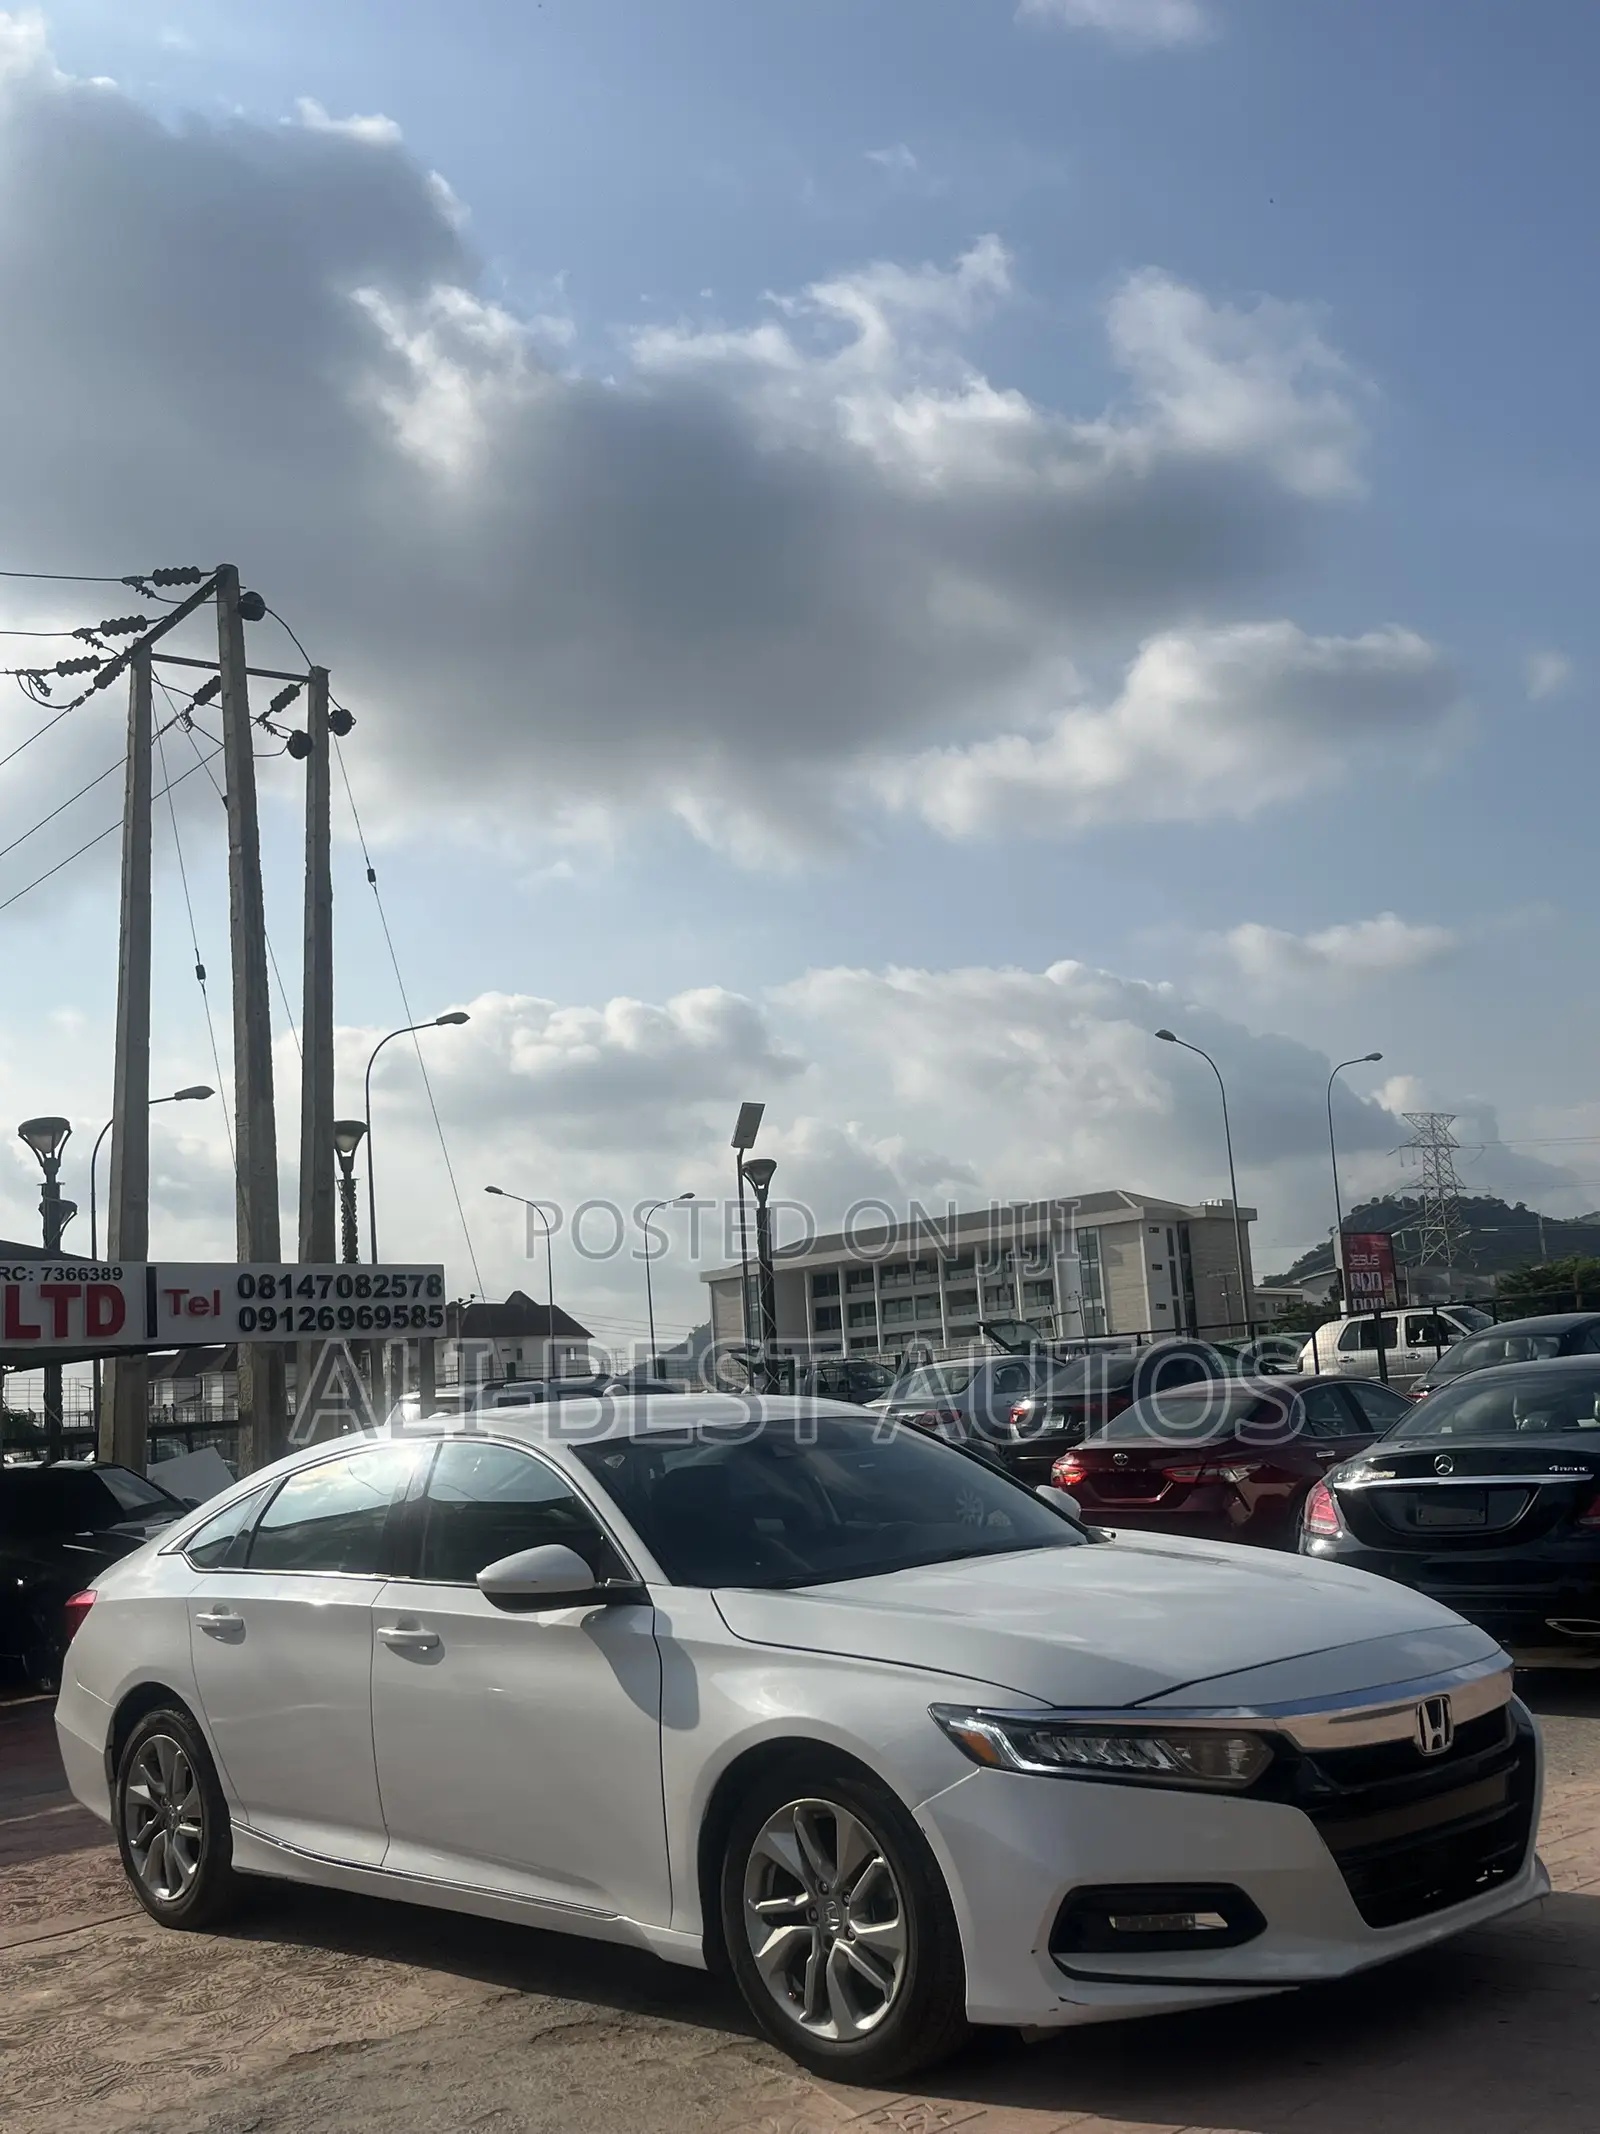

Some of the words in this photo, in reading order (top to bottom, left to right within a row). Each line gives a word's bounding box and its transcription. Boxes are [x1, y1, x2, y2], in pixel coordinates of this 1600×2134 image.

[0, 1266, 34, 1282] RC:
[40, 1266, 124, 1282] 7366389
[237, 1272, 443, 1301] 08147082578
[4, 1284, 126, 1340] LTD
[163, 1288, 221, 1316] Tel
[237, 1303, 445, 1333] 09126969585
